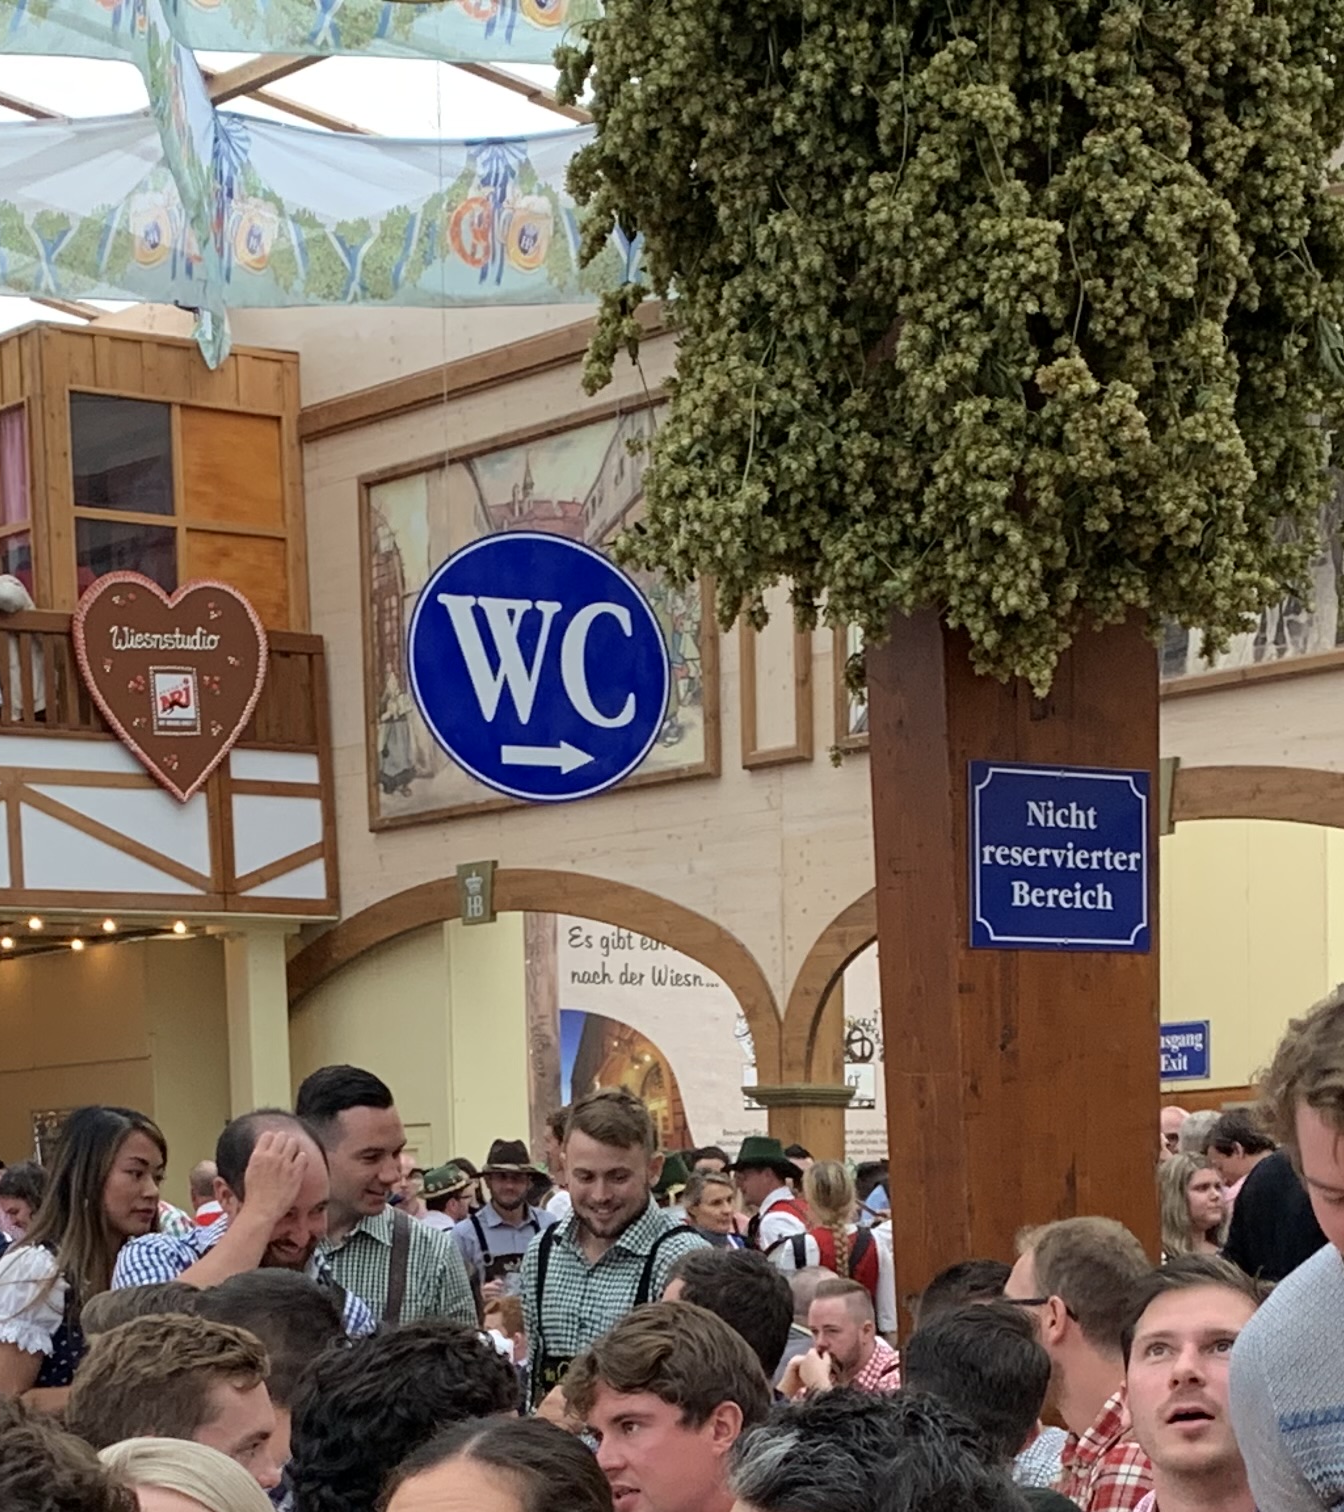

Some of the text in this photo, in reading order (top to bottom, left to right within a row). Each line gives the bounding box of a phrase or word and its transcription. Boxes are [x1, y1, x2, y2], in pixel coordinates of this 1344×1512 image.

[109, 626, 220, 650] Wiesnstudio
[437, 593, 636, 728] WC
[1026, 800, 1098, 830] Nicht
[982, 842, 1141, 871] reservierter
[468, 895, 484, 917] HB
[1011, 880, 1114, 910] Bereich
[568, 926, 593, 949] Es
[601, 927, 635, 957] gibt
[571, 961, 613, 985] nach
[619, 963, 645, 986] der
[1160, 1033, 1203, 1053] sgang
[1160, 1053, 1188, 1071] Exit
